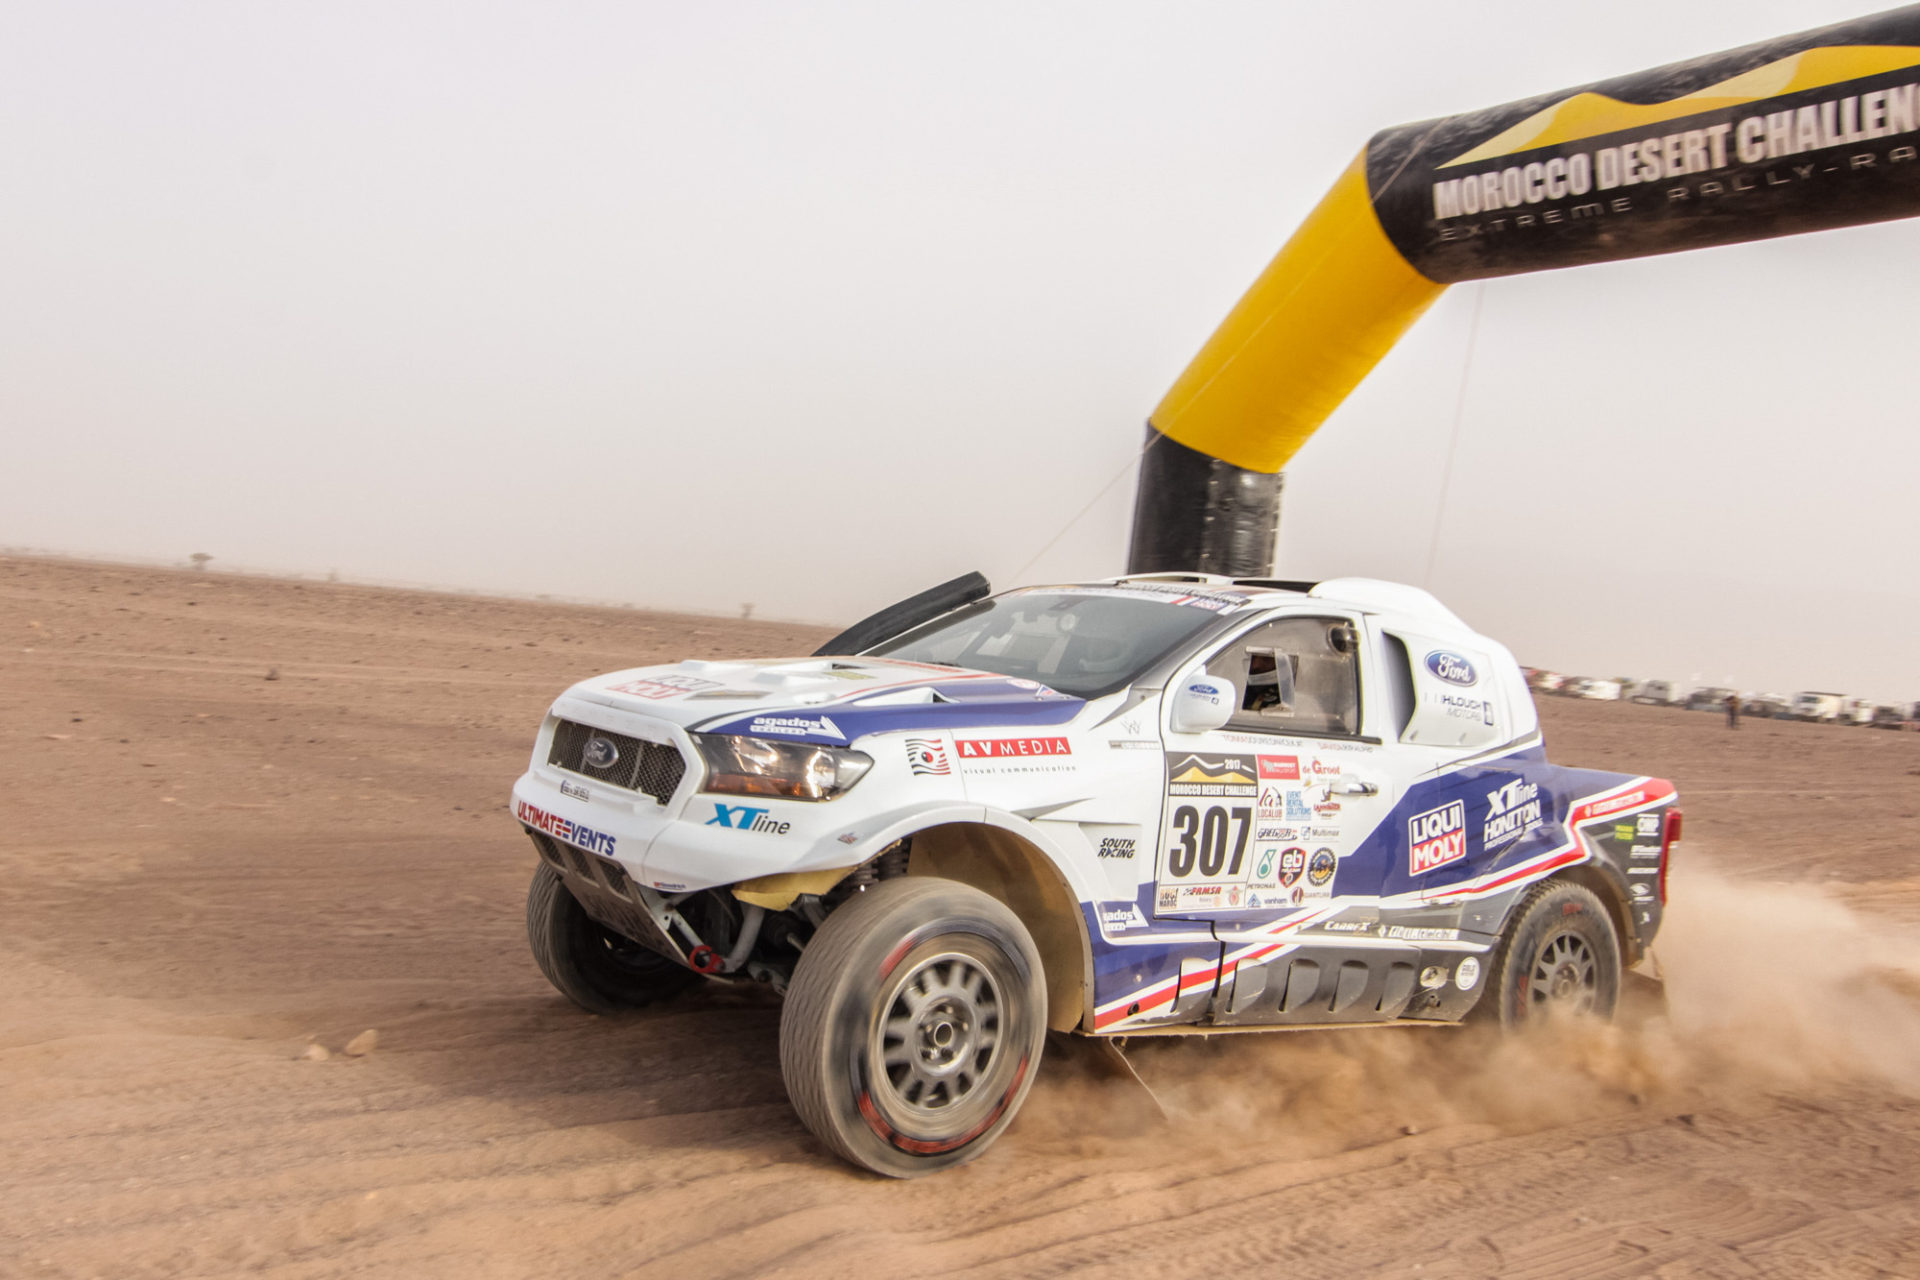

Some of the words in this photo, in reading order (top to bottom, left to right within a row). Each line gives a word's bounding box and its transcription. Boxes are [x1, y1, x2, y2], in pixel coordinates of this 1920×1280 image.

[1433, 152, 1592, 221] MOROCCO
[1595, 122, 1734, 192] DESERT
[1735, 82, 1920, 165] CHALLEN
[1437, 653, 1472, 682] Ford
[753, 716, 821, 729] agados
[963, 741, 993, 756] AV
[1000, 738, 1068, 756] MEDIA
[1001, 764, 1078, 775] communication
[1224, 758, 1241, 770] 2017
[1312, 759, 1341, 775] Groot
[1169, 784, 1202, 796] MOROCCO
[1202, 784, 1225, 796] DESERT
[1225, 784, 1258, 796] CHALLENGE
[705, 802, 792, 836] XTline
[1411, 805, 1462, 845] LIQUI
[1100, 837, 1136, 849] SOUTH
[1168, 805, 1253, 878] 307
[1412, 830, 1464, 871] MOLY
